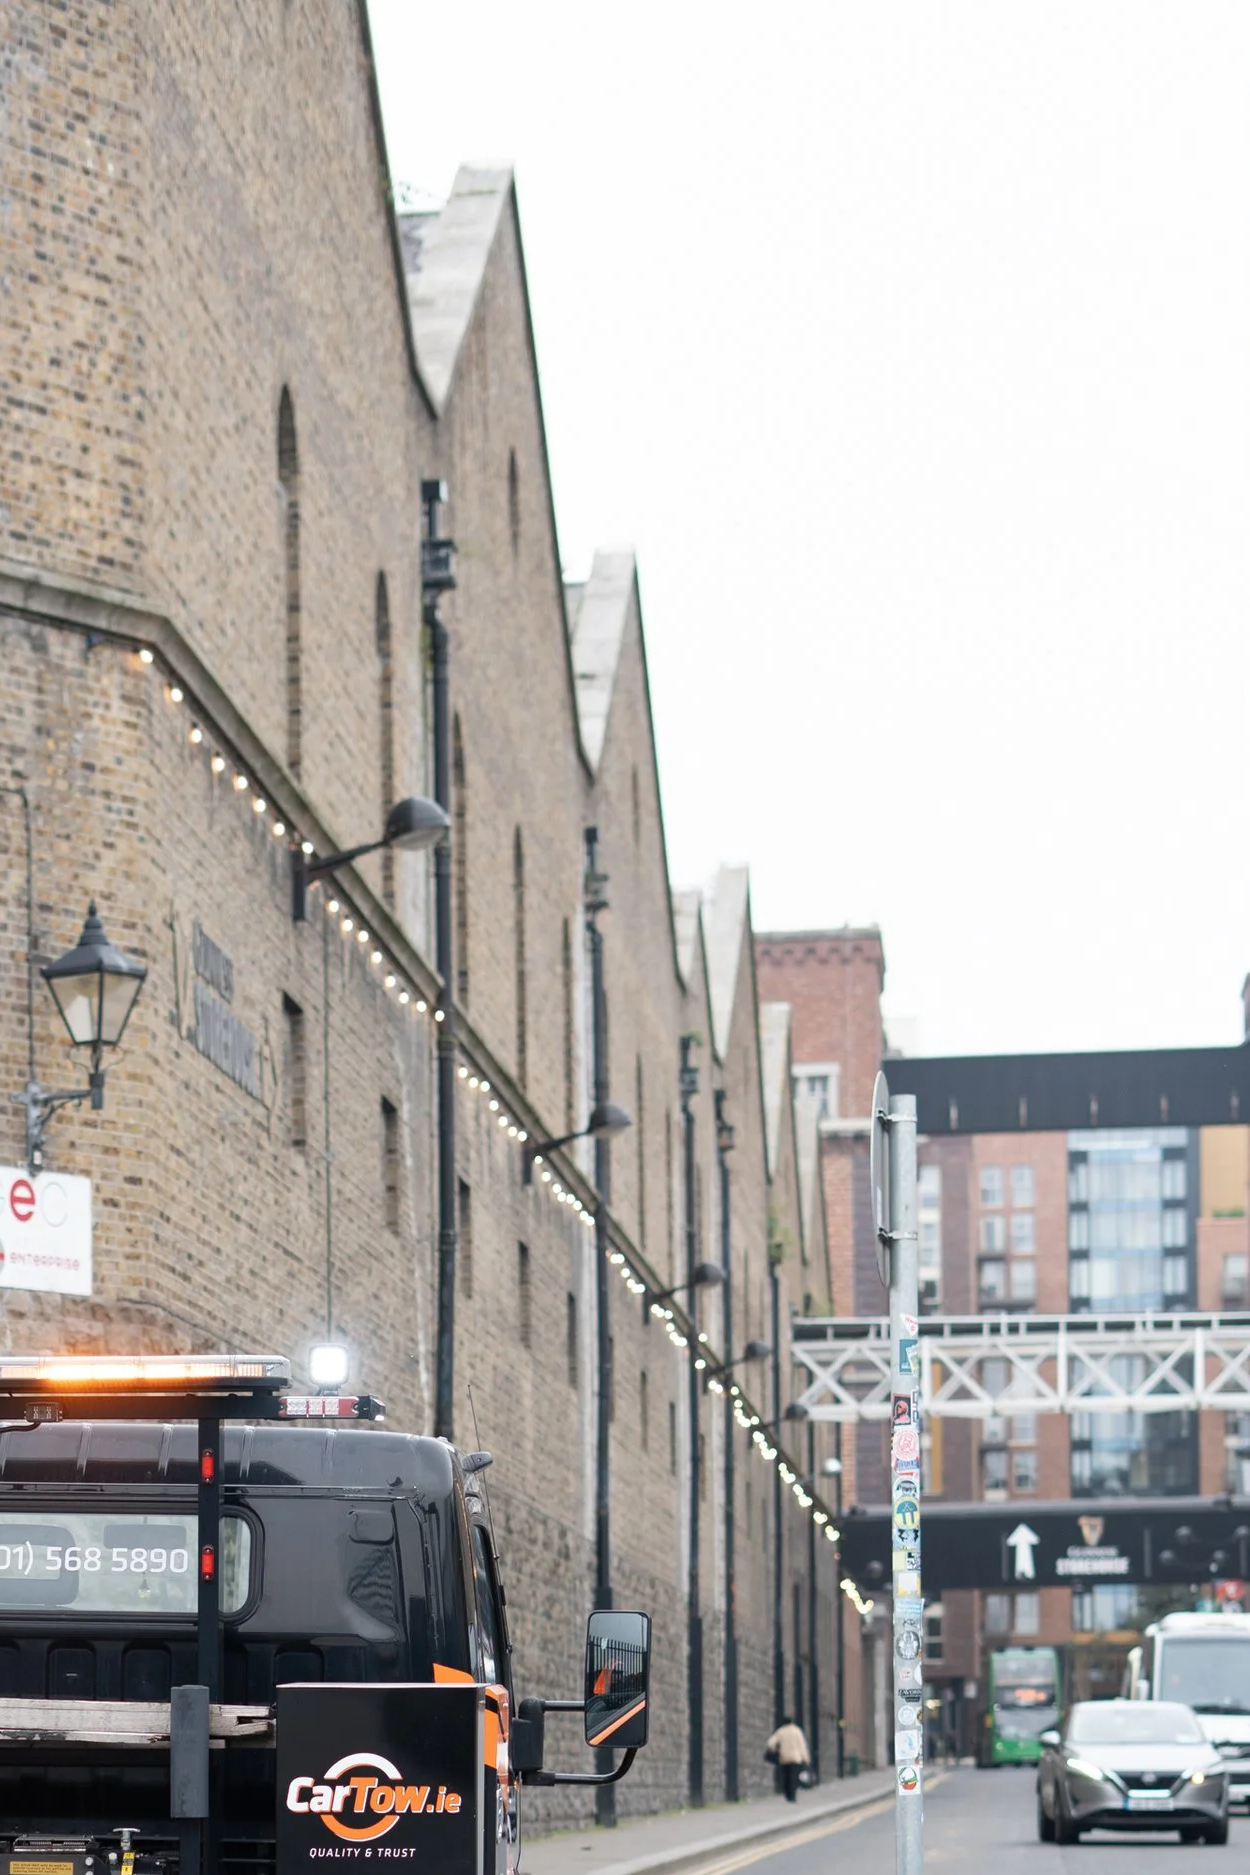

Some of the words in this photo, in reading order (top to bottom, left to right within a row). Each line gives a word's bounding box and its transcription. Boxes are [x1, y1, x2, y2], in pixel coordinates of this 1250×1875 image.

[45, 1546, 101, 1572] 568
[111, 1547, 189, 1573] 5890
[309, 1847, 361, 1859] QUALITY
[364, 1848, 373, 1857] &
[377, 1848, 416, 1858] TRUST
